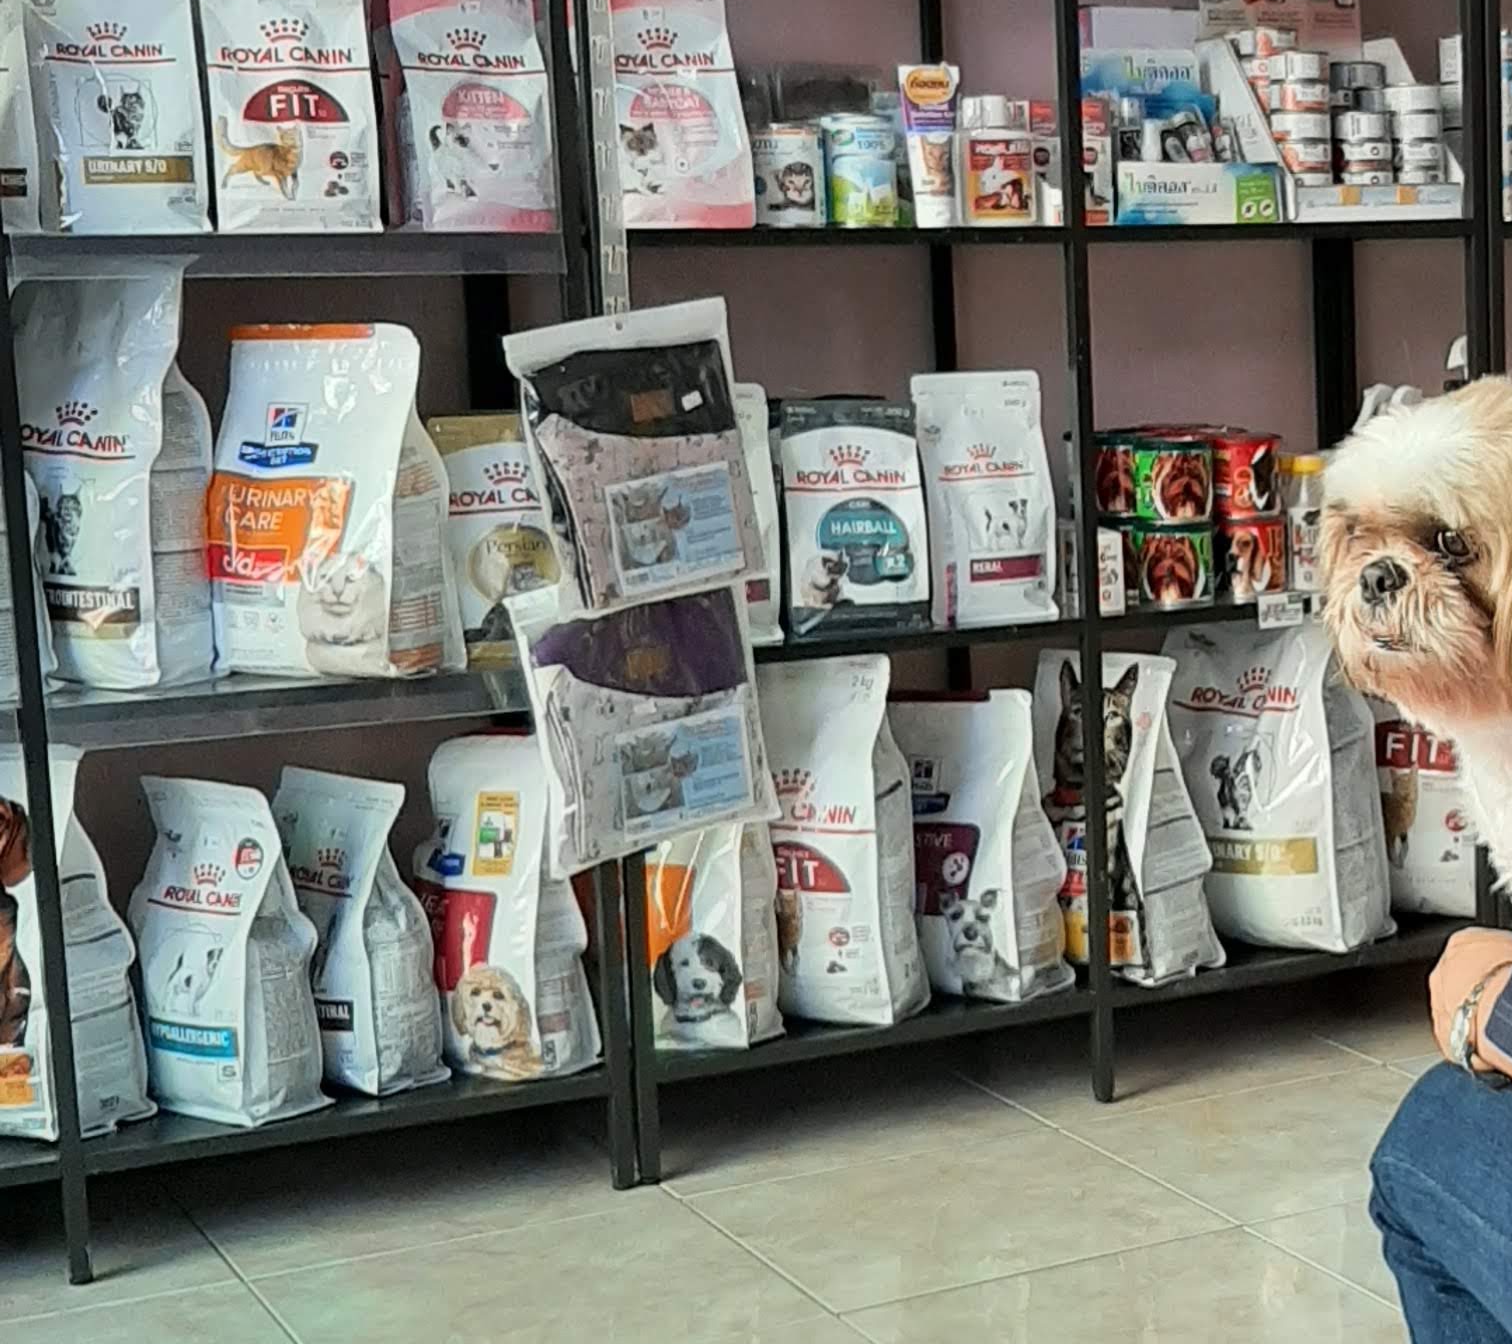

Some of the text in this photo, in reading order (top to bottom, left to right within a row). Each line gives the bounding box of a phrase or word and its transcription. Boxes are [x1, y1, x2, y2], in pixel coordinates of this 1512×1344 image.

[56, 42, 163, 57] ROYAL CANIN
[220, 46, 353, 64] ROYAL CANIN
[417, 52, 526, 69] ROYAL CANIN
[616, 52, 715, 69] OYAL CANIN
[458, 89, 504, 104] KITTEN
[269, 94, 319, 118] FIT
[87, 158, 143, 175] URINARY
[21, 422, 127, 453] OYAL CANIN
[943, 460, 1025, 476] ROYAL CANIN
[796, 470, 906, 485] ROYAL CANIN
[229, 484, 319, 508] URINARY
[449, 491, 505, 508] ROYAL
[224, 507, 281, 532] CARE
[830, 518, 897, 534] HAIRBALL
[486, 538, 547, 556] Persian
[971, 560, 1003, 574] RENAL
[851, 675, 874, 690] 2 kg
[1191, 685, 1246, 709] ROYAL
[1386, 732, 1442, 760] FIT
